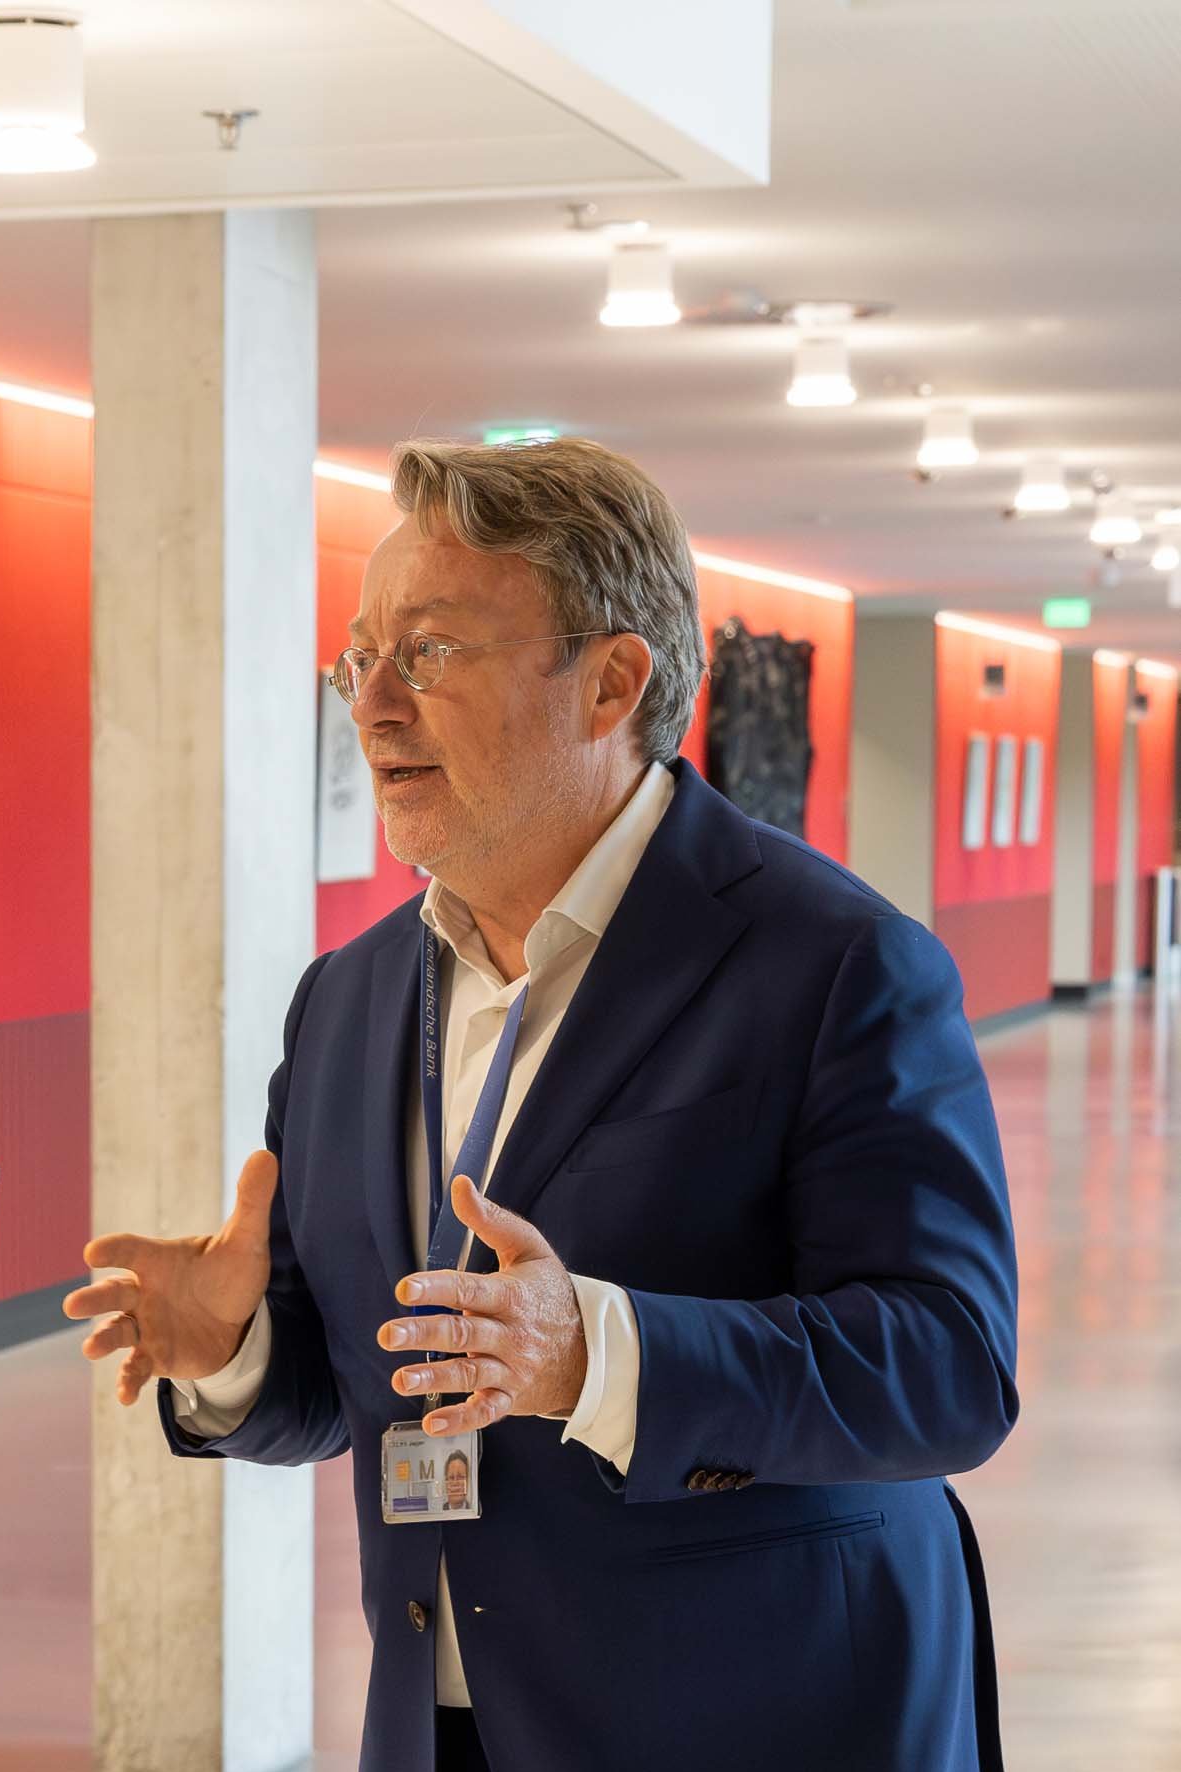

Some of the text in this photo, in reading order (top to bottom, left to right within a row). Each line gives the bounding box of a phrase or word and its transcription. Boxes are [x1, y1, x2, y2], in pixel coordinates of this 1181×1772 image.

[425, 929, 437, 1079] ederlandsche Bank
[419, 1459, 435, 1480] M
